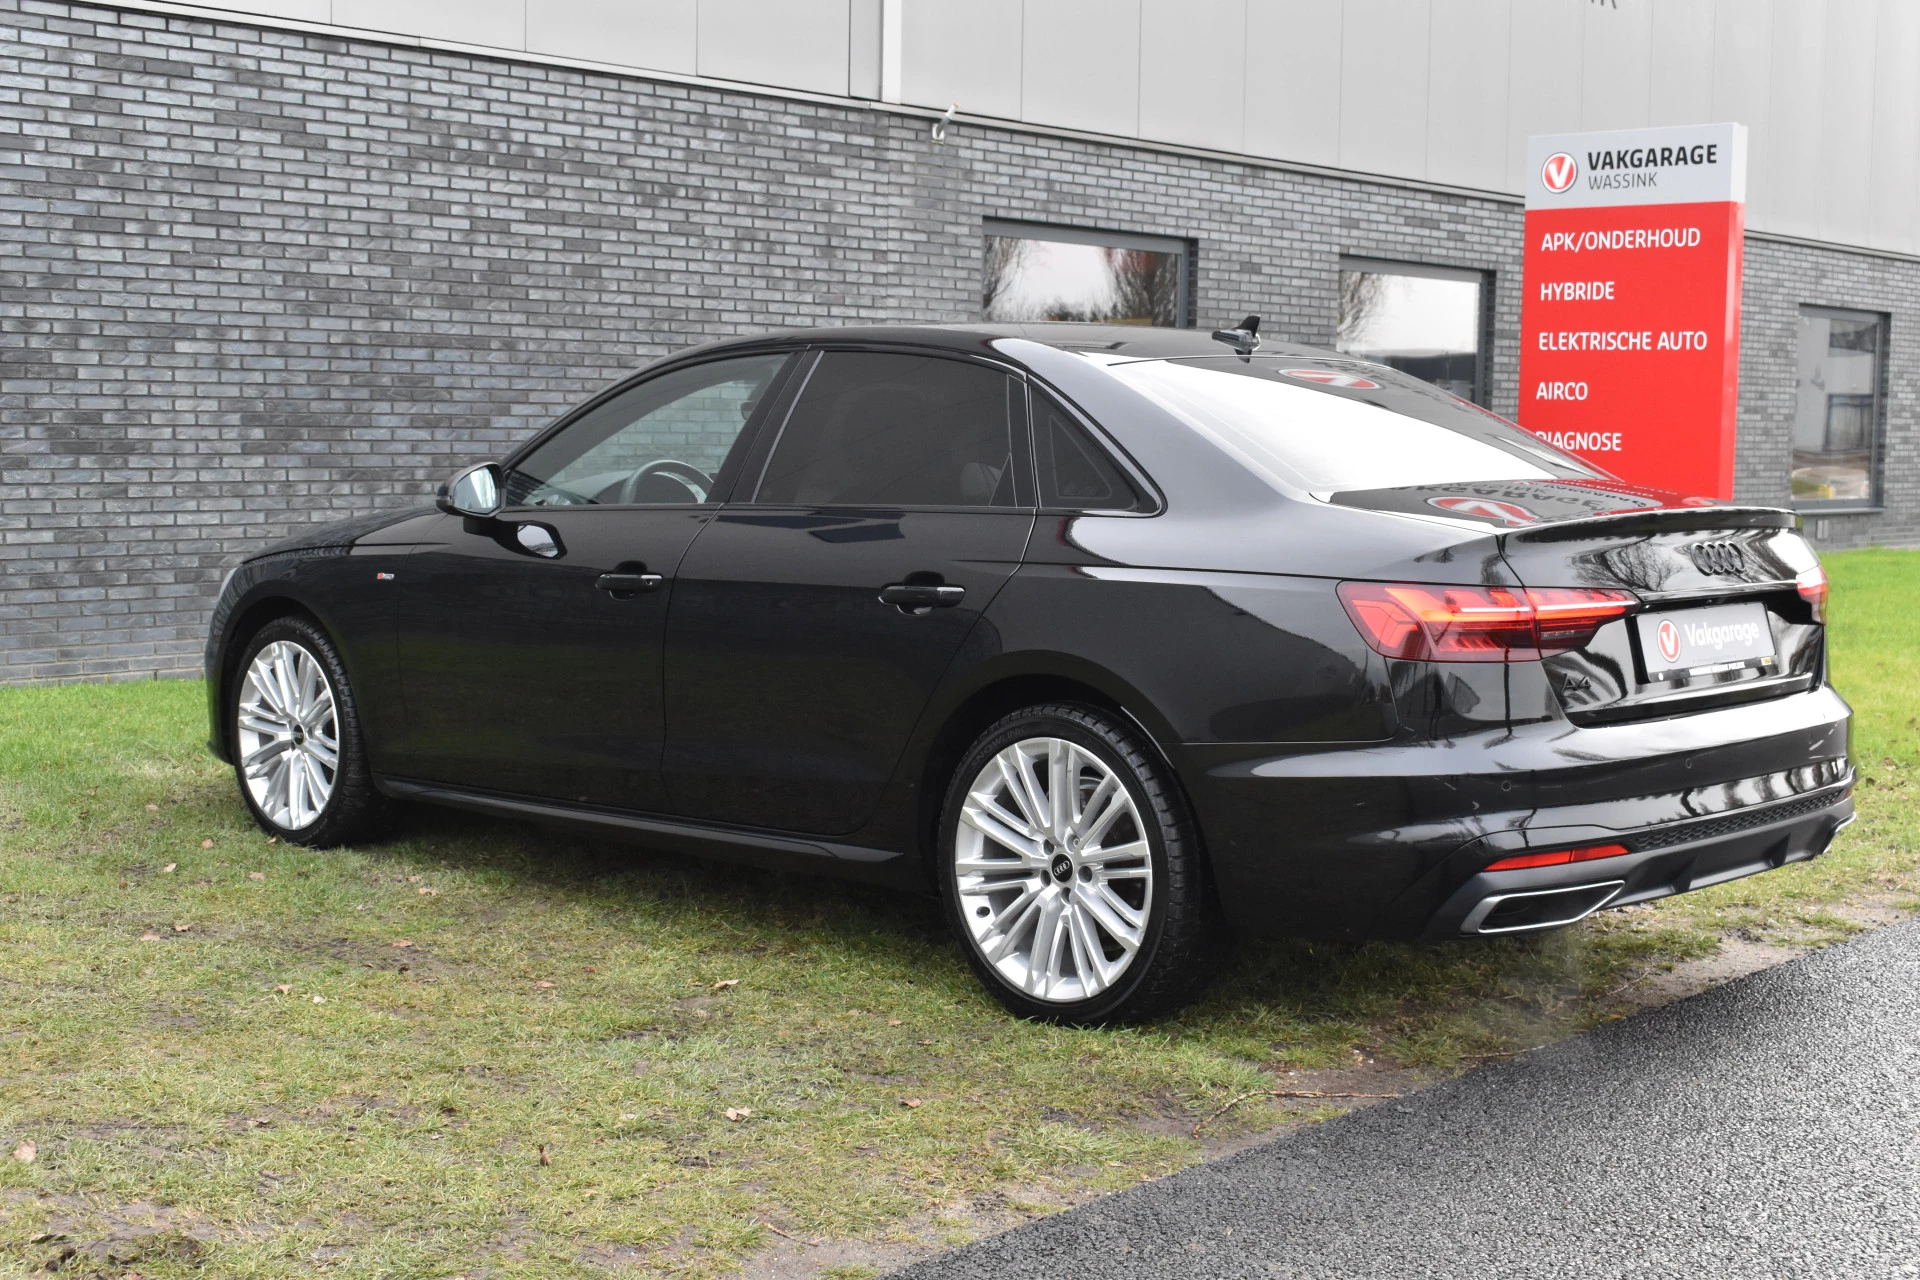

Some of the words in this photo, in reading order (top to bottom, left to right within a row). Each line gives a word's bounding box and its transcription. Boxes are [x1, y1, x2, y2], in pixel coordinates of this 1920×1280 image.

[1588, 144, 1718, 171] VAKGARAGE
[1588, 172, 1658, 190] WASSINK
[1541, 227, 1701, 253] APK/ONDERHOUD
[1540, 281, 1615, 301] HYBRIDE
[1538, 332, 1652, 350] ELEKTRISCHE
[1657, 331, 1708, 350] AUTO
[1536, 382, 1589, 400] AIRCO
[1684, 622, 1760, 650] Vakgarage
[1561, 672, 1591, 696] A4
